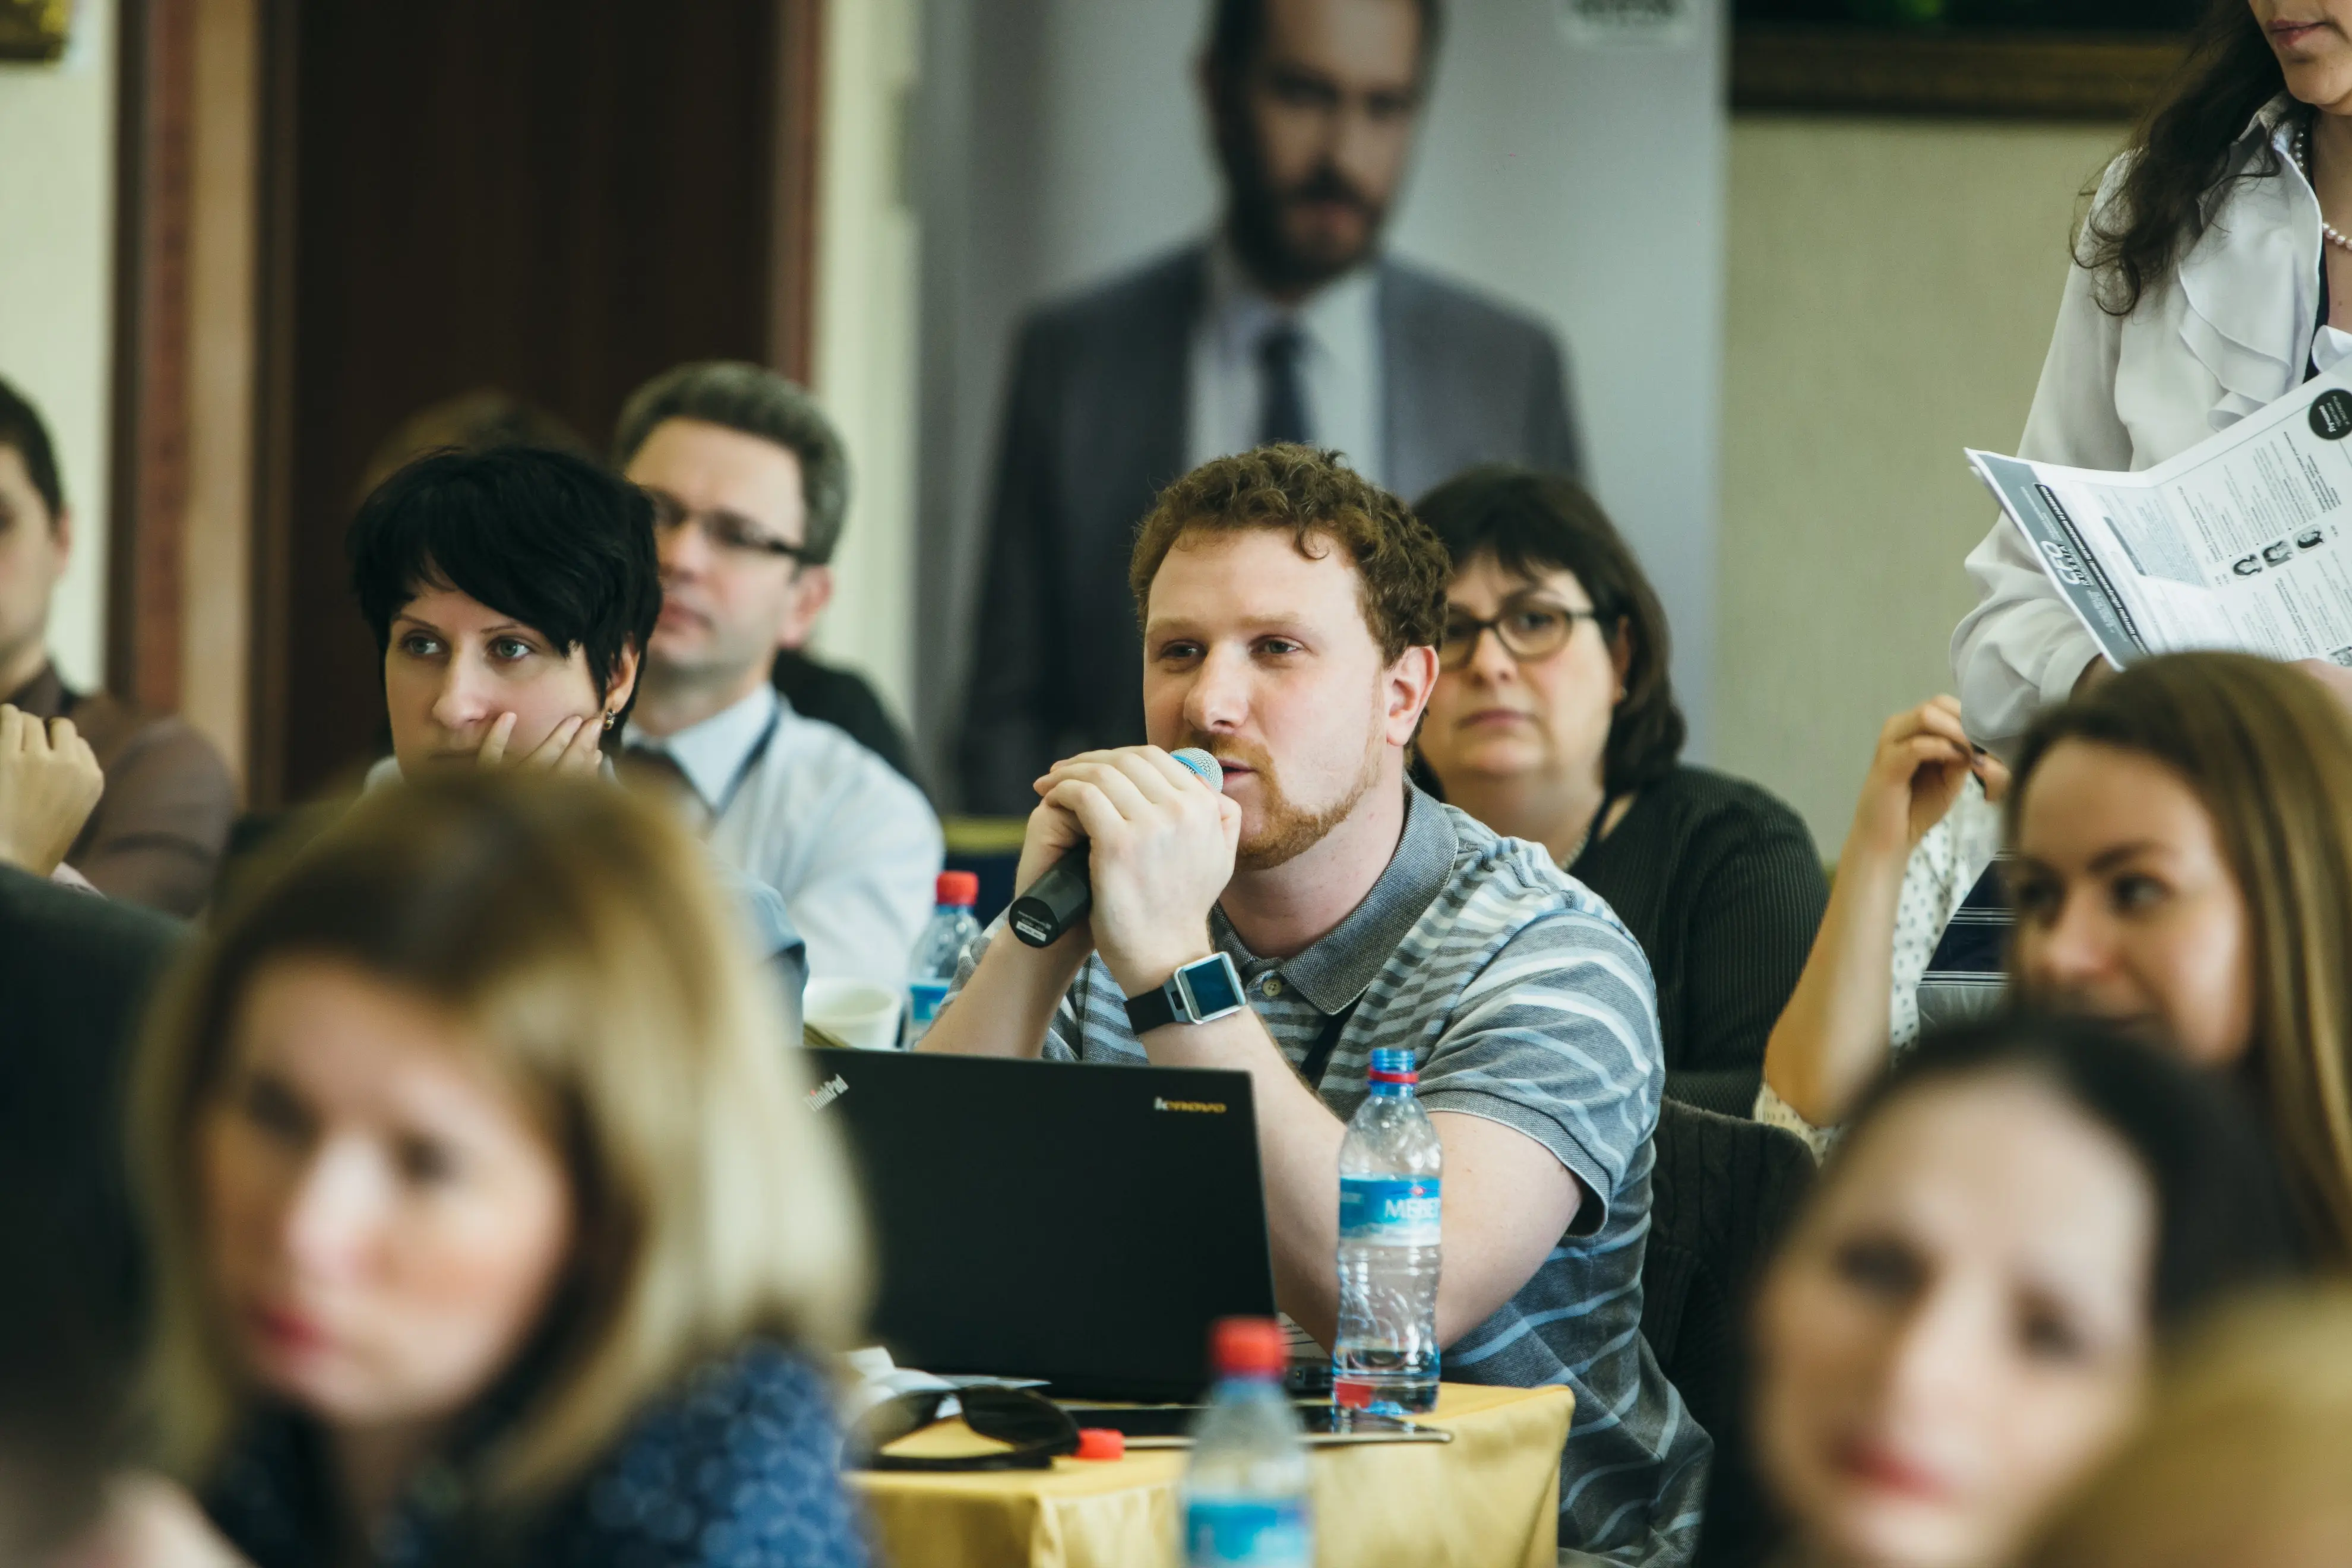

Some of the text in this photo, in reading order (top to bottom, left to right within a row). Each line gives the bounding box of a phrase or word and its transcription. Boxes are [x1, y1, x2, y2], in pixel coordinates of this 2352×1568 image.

[2040, 540, 2079, 584] CFO
[2059, 545, 2089, 586] RUSSIA
[1155, 1096, 1226, 1113] lenovo
